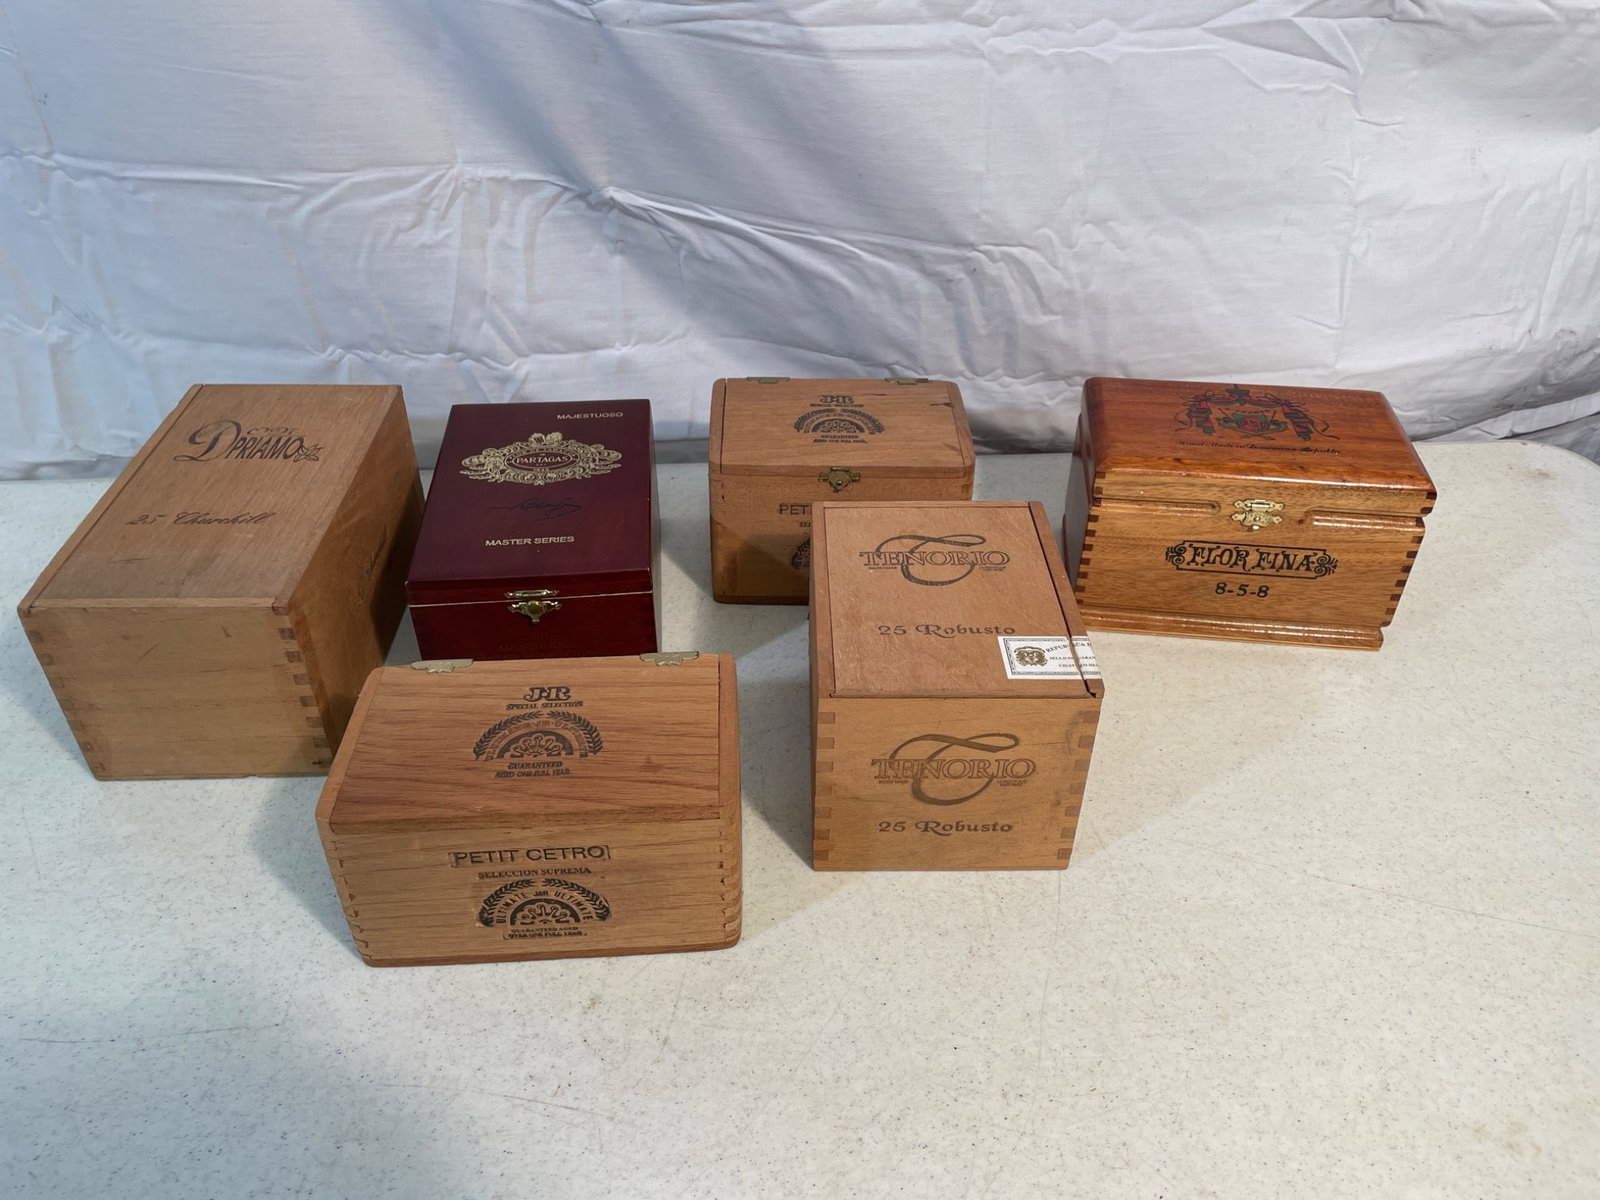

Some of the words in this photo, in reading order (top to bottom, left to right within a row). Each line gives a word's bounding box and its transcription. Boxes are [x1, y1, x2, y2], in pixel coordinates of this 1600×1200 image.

[556, 411, 624, 420] MAJESTUOSO
[516, 456, 569, 464] PARTAGAS
[778, 503, 812, 516] PETI
[173, 511, 277, 525] Churchill
[485, 537, 532, 546] MASTER
[534, 536, 575, 545] SERIES
[1186, 543, 1250, 572] FLOR
[1251, 548, 1317, 573] FINA
[1214, 582, 1270, 598] 8-5-8
[877, 625, 907, 636] 25
[915, 624, 1016, 639] Robusto
[505, 702, 539, 710] SPECIAL
[540, 700, 584, 708] SELECTION
[507, 760, 563, 770] GUARANTEED
[870, 758, 1037, 780] TENORIO
[878, 821, 906, 833] 25
[915, 820, 1013, 836] Robusto
[452, 850, 519, 866] PETIT
[525, 845, 606, 862] CETRO
[477, 868, 539, 880] SELECCION
[540, 867, 592, 877] SUPREMA
[495, 892, 528, 924] ULTIMATE
[554, 891, 594, 920] ULTIMATE
